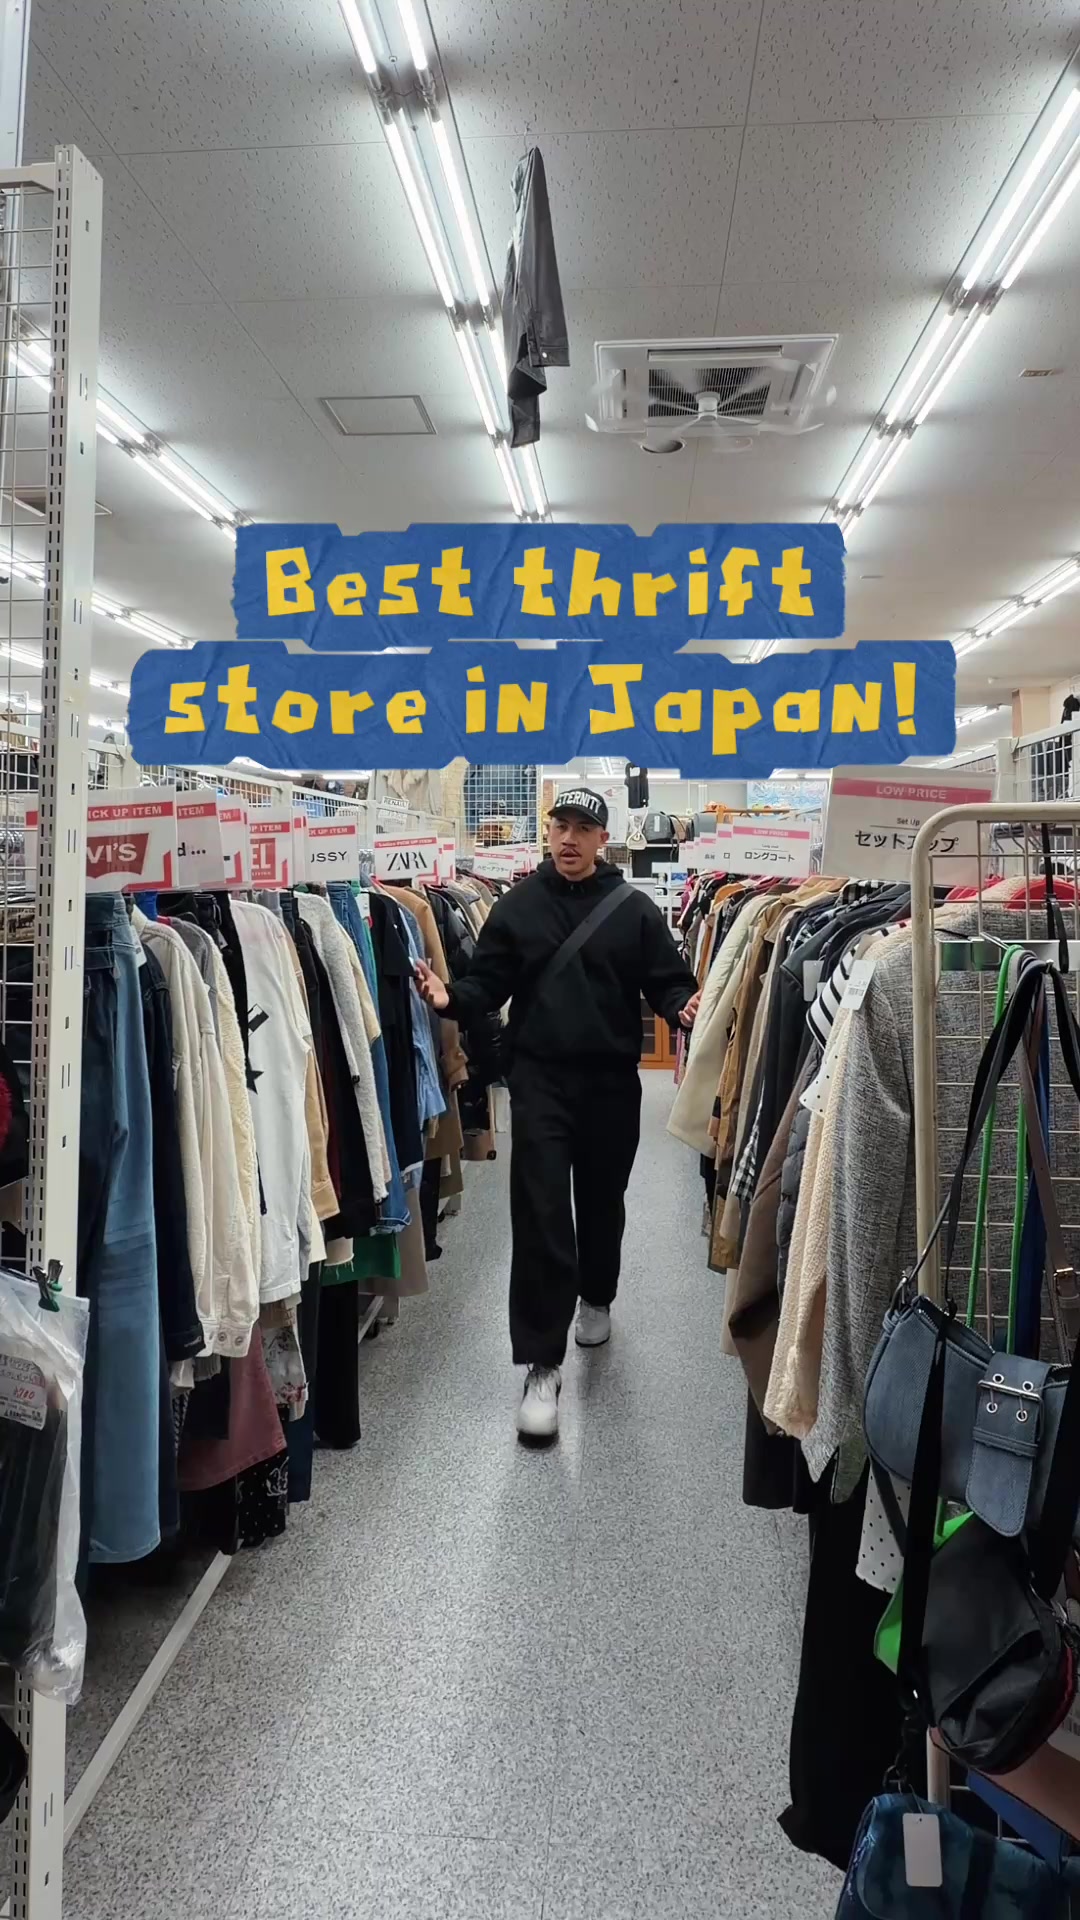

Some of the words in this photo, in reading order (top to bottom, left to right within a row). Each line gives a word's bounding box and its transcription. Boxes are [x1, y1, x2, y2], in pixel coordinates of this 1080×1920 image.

[875, 785, 904, 795] LOW
[908, 788, 947, 799] PRICE
[555, 790, 602, 814] ETERNITY
[113, 808, 129, 817] UP
[133, 806, 161, 816] ITEM
[178, 806, 204, 817] ITEM
[897, 817, 909, 825] Set
[260, 824, 282, 832] ITEM
[386, 850, 428, 871] ZARA
[744, 851, 795, 863] ロングコート
